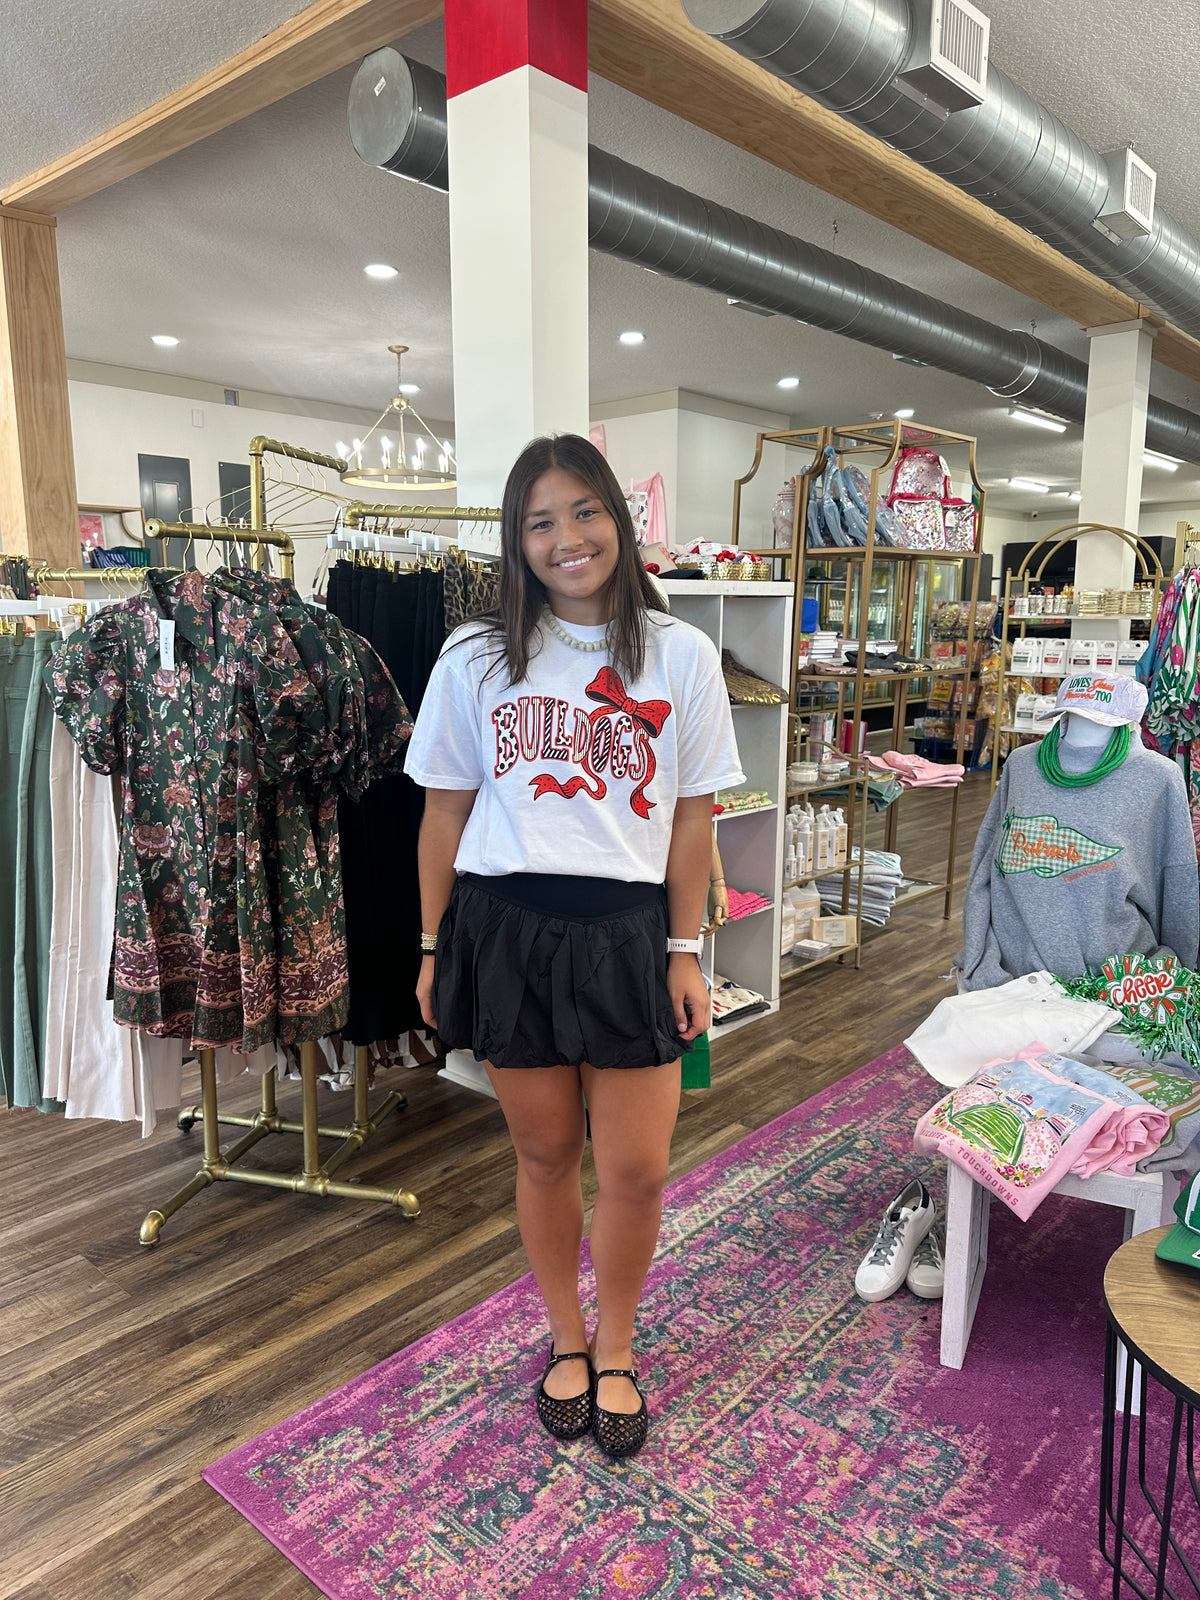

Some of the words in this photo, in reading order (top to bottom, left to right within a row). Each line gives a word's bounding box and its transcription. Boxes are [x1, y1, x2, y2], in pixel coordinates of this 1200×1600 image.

[1069, 677, 1092, 689] LOVES
[1086, 678, 1115, 693] Jesus
[1095, 690, 1112, 704] TOO
[491, 696, 649, 780] BULLDOGS
[1012, 832, 1082, 862] Patriots
[957, 1146, 1019, 1207] TOUCHDOWNS
